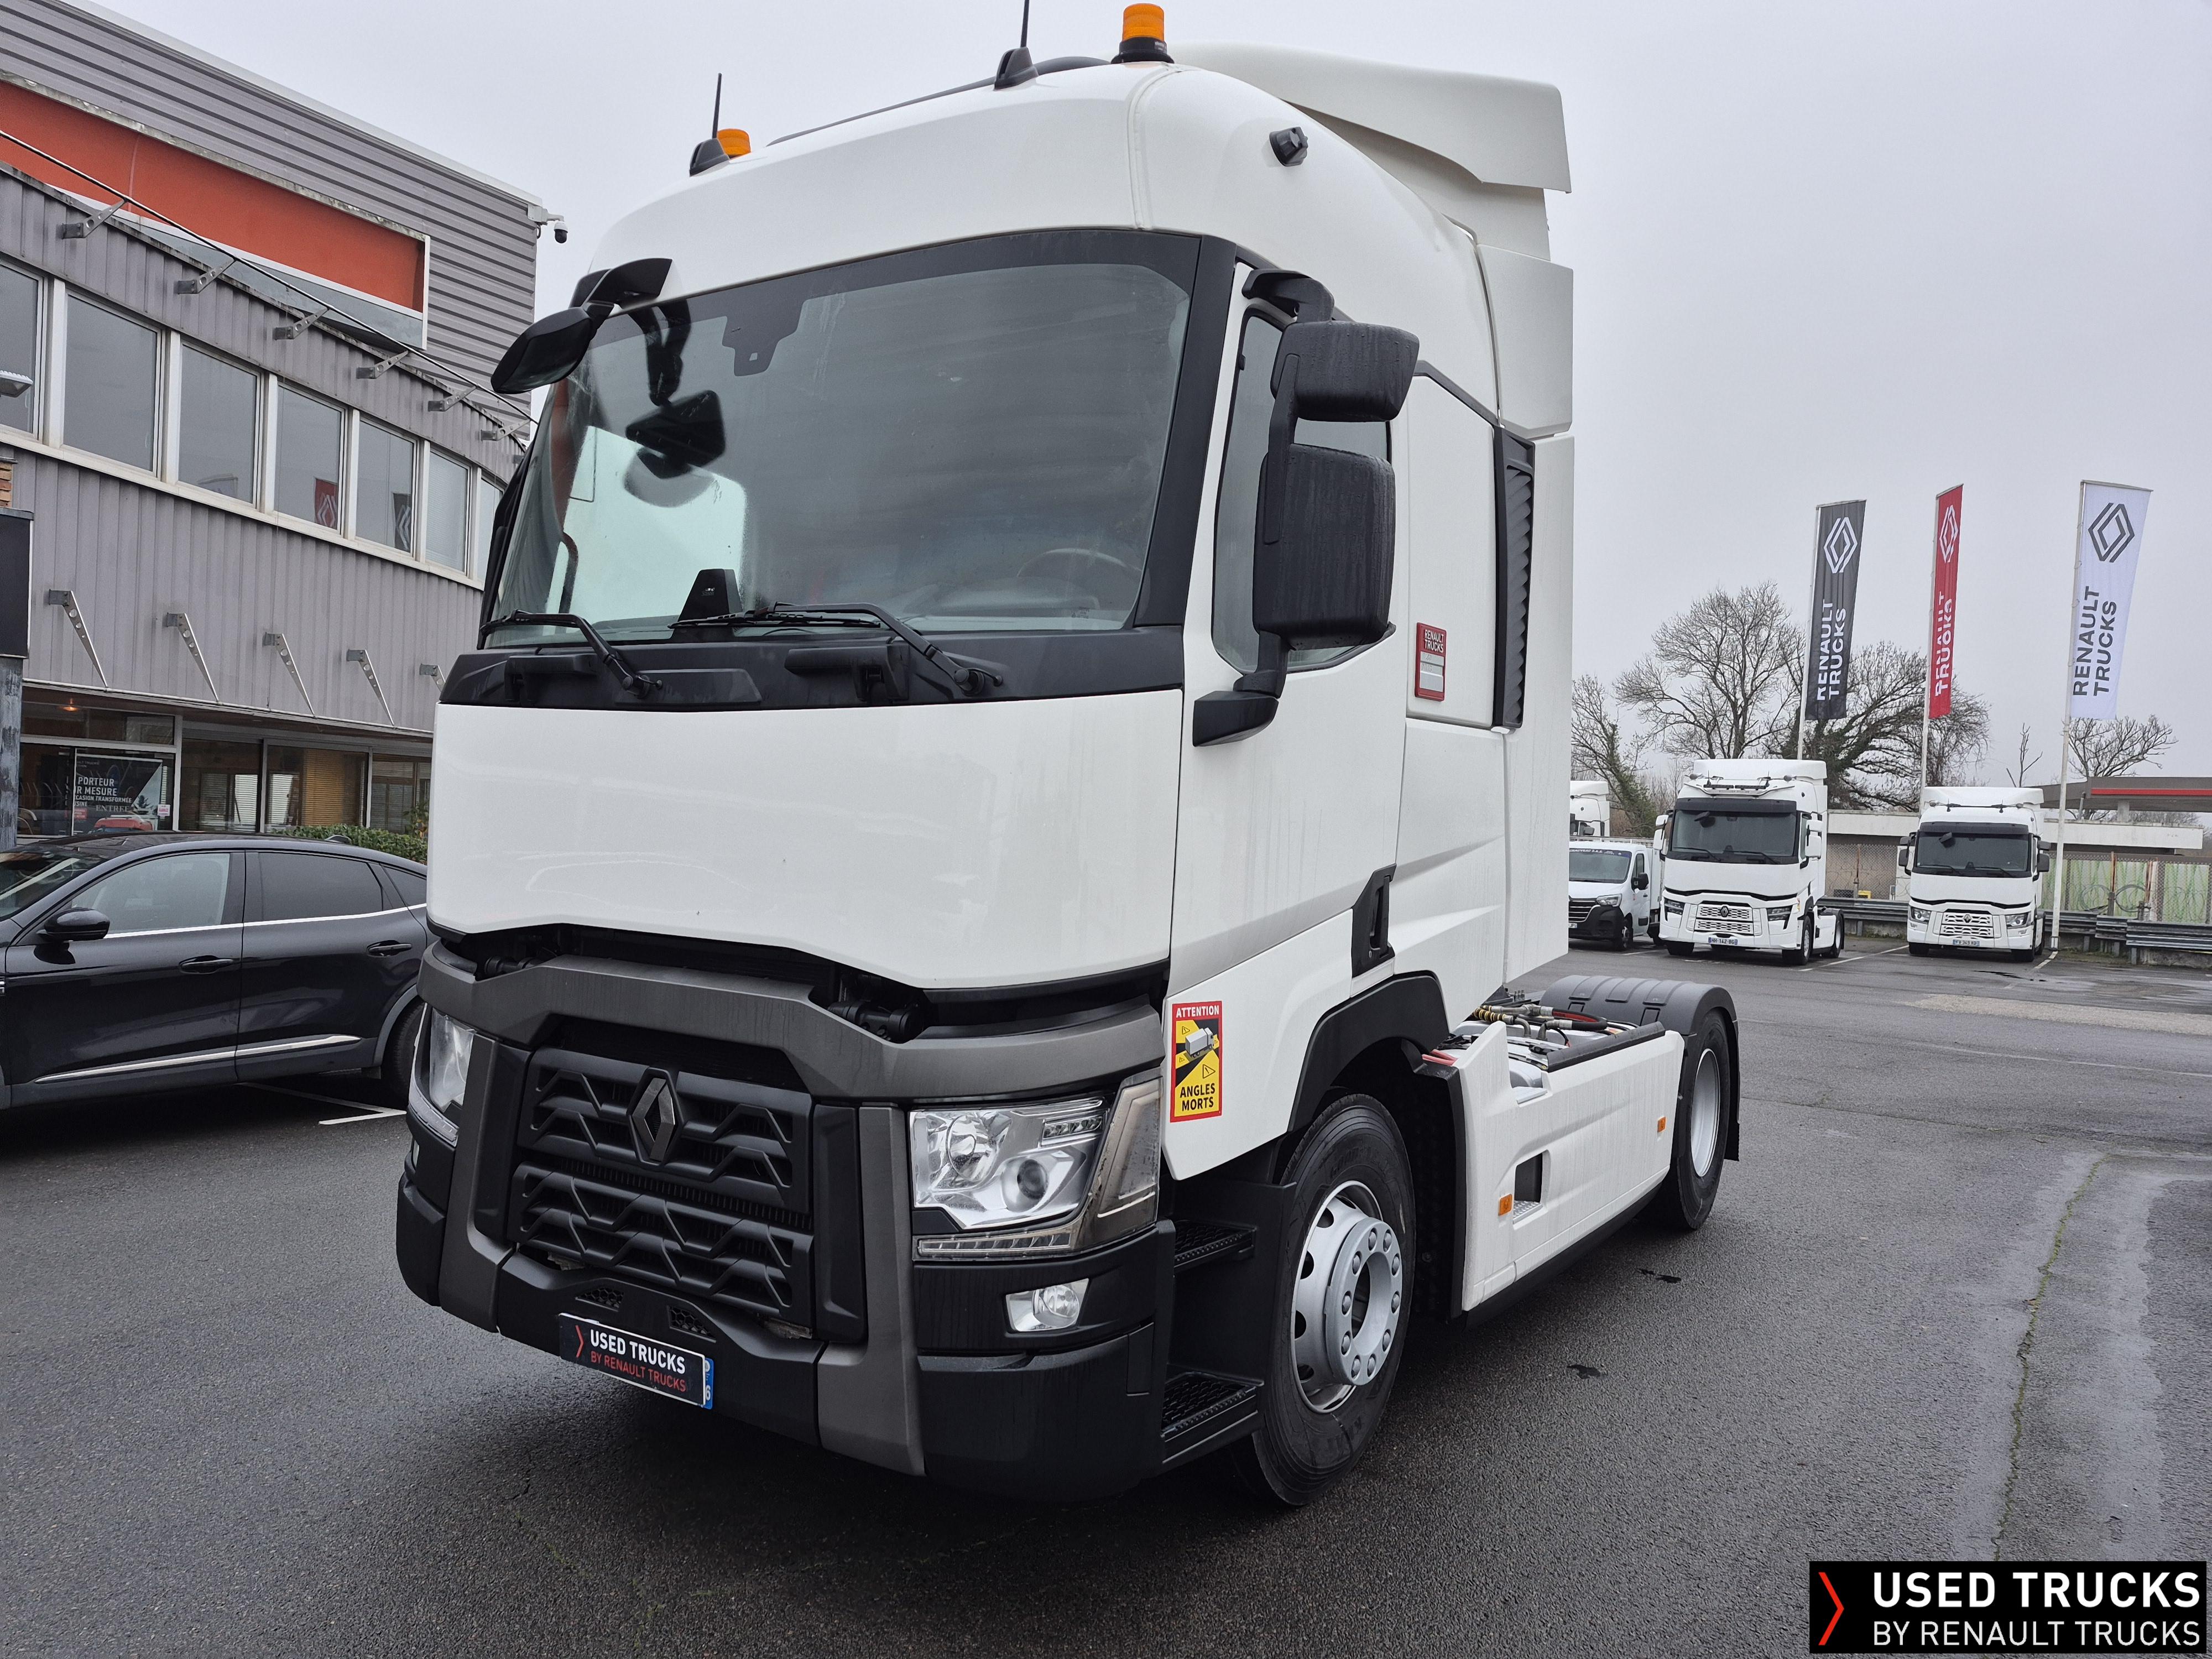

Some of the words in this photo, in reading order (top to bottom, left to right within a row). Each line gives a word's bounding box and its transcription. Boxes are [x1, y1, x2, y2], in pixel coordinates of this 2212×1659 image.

[1425, 629, 1444, 643] RENAULT
[2073, 586, 2099, 696] RENAULT
[1425, 639, 1444, 653] TRUCKS
[1817, 599, 1833, 701] RENAULT
[1829, 608, 1846, 700] TRUCKS
[2093, 601, 2117, 696] TRUCKS
[78, 776, 114, 787] PORTEUR
[84, 787, 117, 796] MESURE
[1176, 1005, 1219, 1018] ATTENTION
[1180, 1083, 1215, 1098] ANGLES
[1182, 1096, 1214, 1112] MORTS
[590, 1329, 626, 1355] USED
[629, 1340, 686, 1374] TRUCKS
[591, 1350, 602, 1364] BY
[604, 1355, 646, 1379] RENAULT
[648, 1369, 687, 1392] TRUCKS
